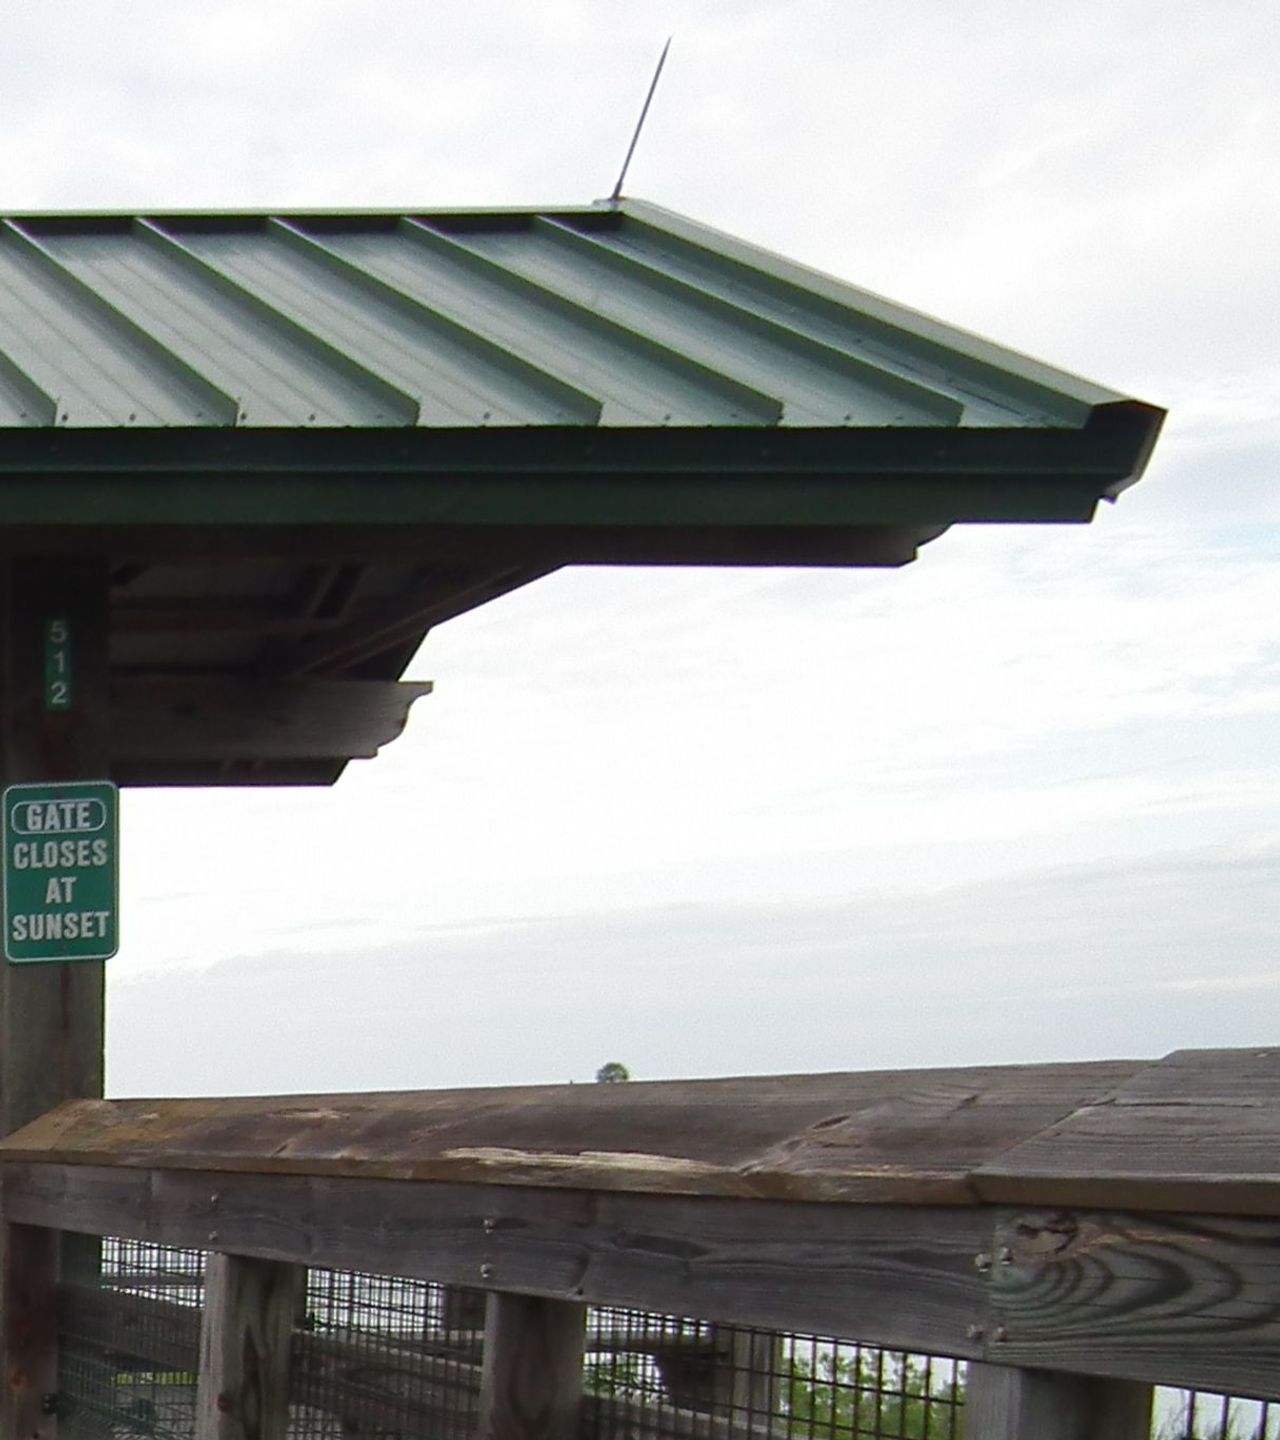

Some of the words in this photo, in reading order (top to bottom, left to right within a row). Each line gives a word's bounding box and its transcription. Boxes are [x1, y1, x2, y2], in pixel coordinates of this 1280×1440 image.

[50, 621, 67, 704] 512
[26, 803, 91, 831] GATE
[13, 839, 108, 869] CLOSES
[45, 877, 77, 904] AT
[12, 911, 110, 941] SUNSET
